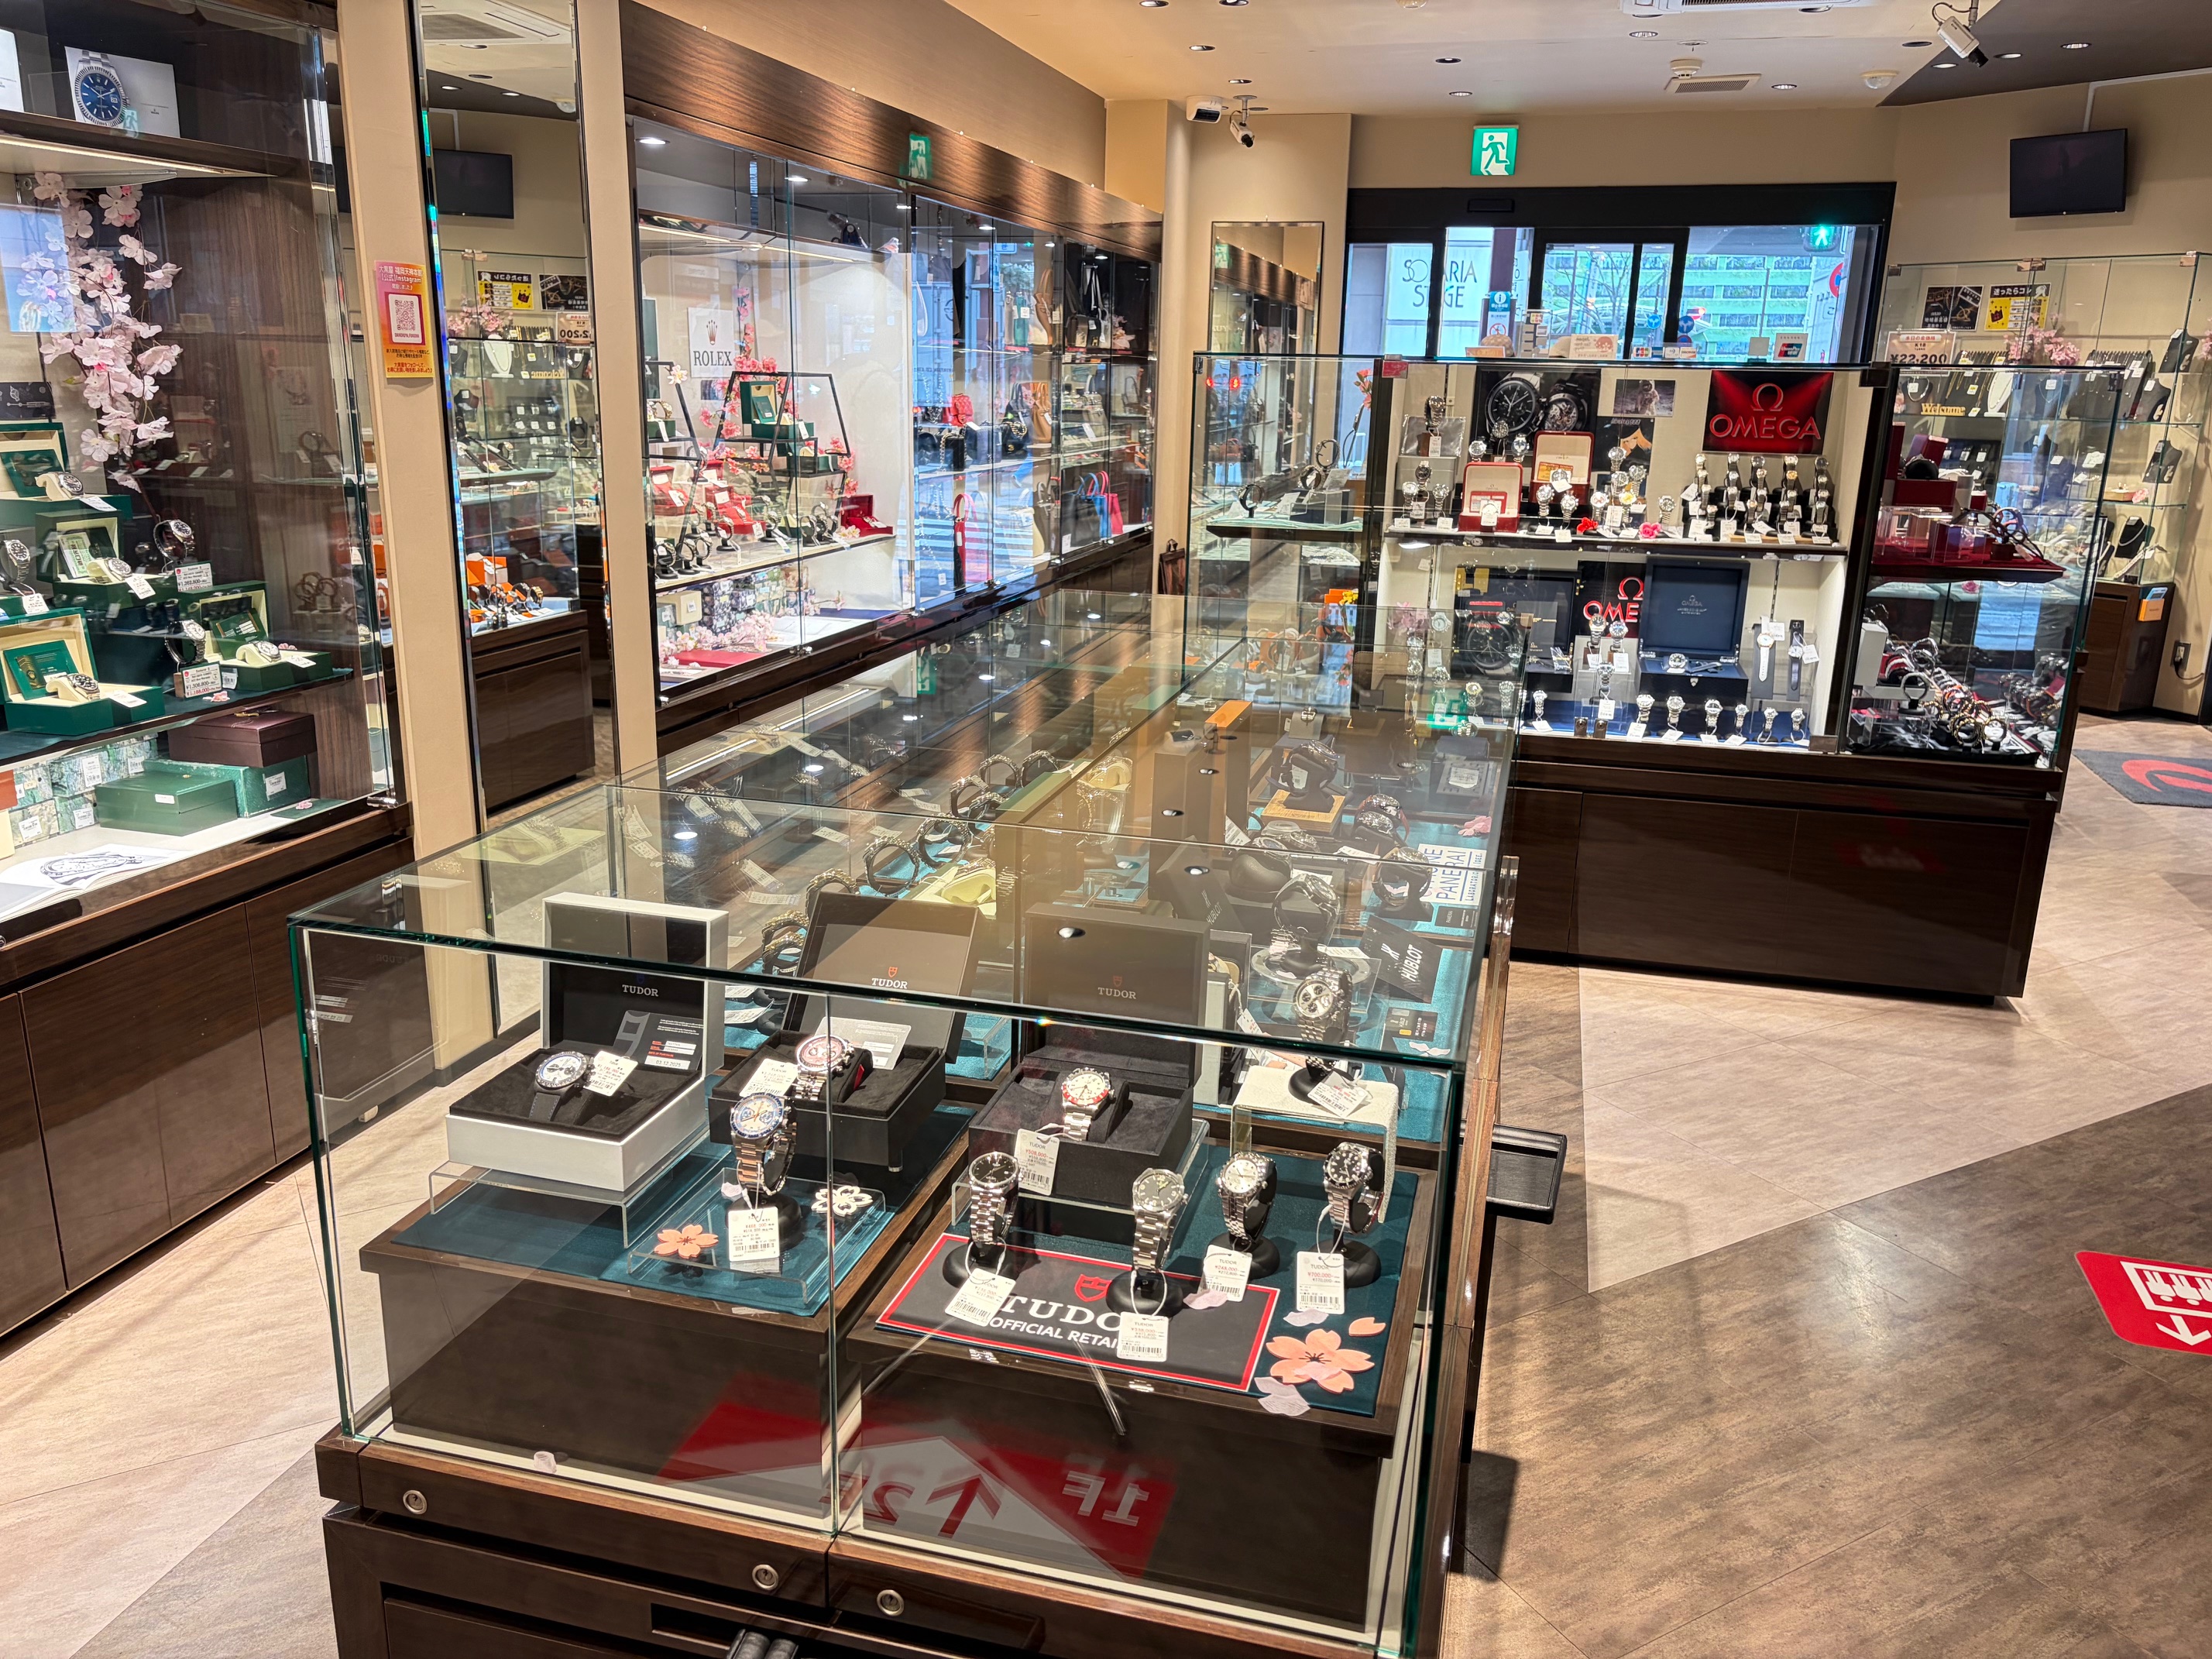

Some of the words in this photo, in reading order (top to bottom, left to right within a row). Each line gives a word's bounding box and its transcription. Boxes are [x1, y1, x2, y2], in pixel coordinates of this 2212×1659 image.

[379, 266, 393, 274] 大黒屋
[1403, 259, 1477, 283] SORIA
[1994, 287, 2032, 296] 迷ったらコレ
[693, 350, 733, 366] ROLEX
[1890, 354, 1947, 364] ¥22,200
[1922, 403, 1966, 415] Welcome
[1709, 414, 1821, 440] OMEGA
[1583, 600, 1639, 623] OME
[1436, 850, 1466, 900] PANERAI
[1400, 943, 1424, 982] HUBLOT
[622, 984, 658, 997] TUDOR
[871, 977, 908, 989] TUDOR
[1098, 987, 1137, 999] TUDOR
[1001, 1295, 1121, 1332] TUDO
[990, 1317, 1064, 1340] OFFICIAL
[1067, 1330, 1118, 1349] RETAI
